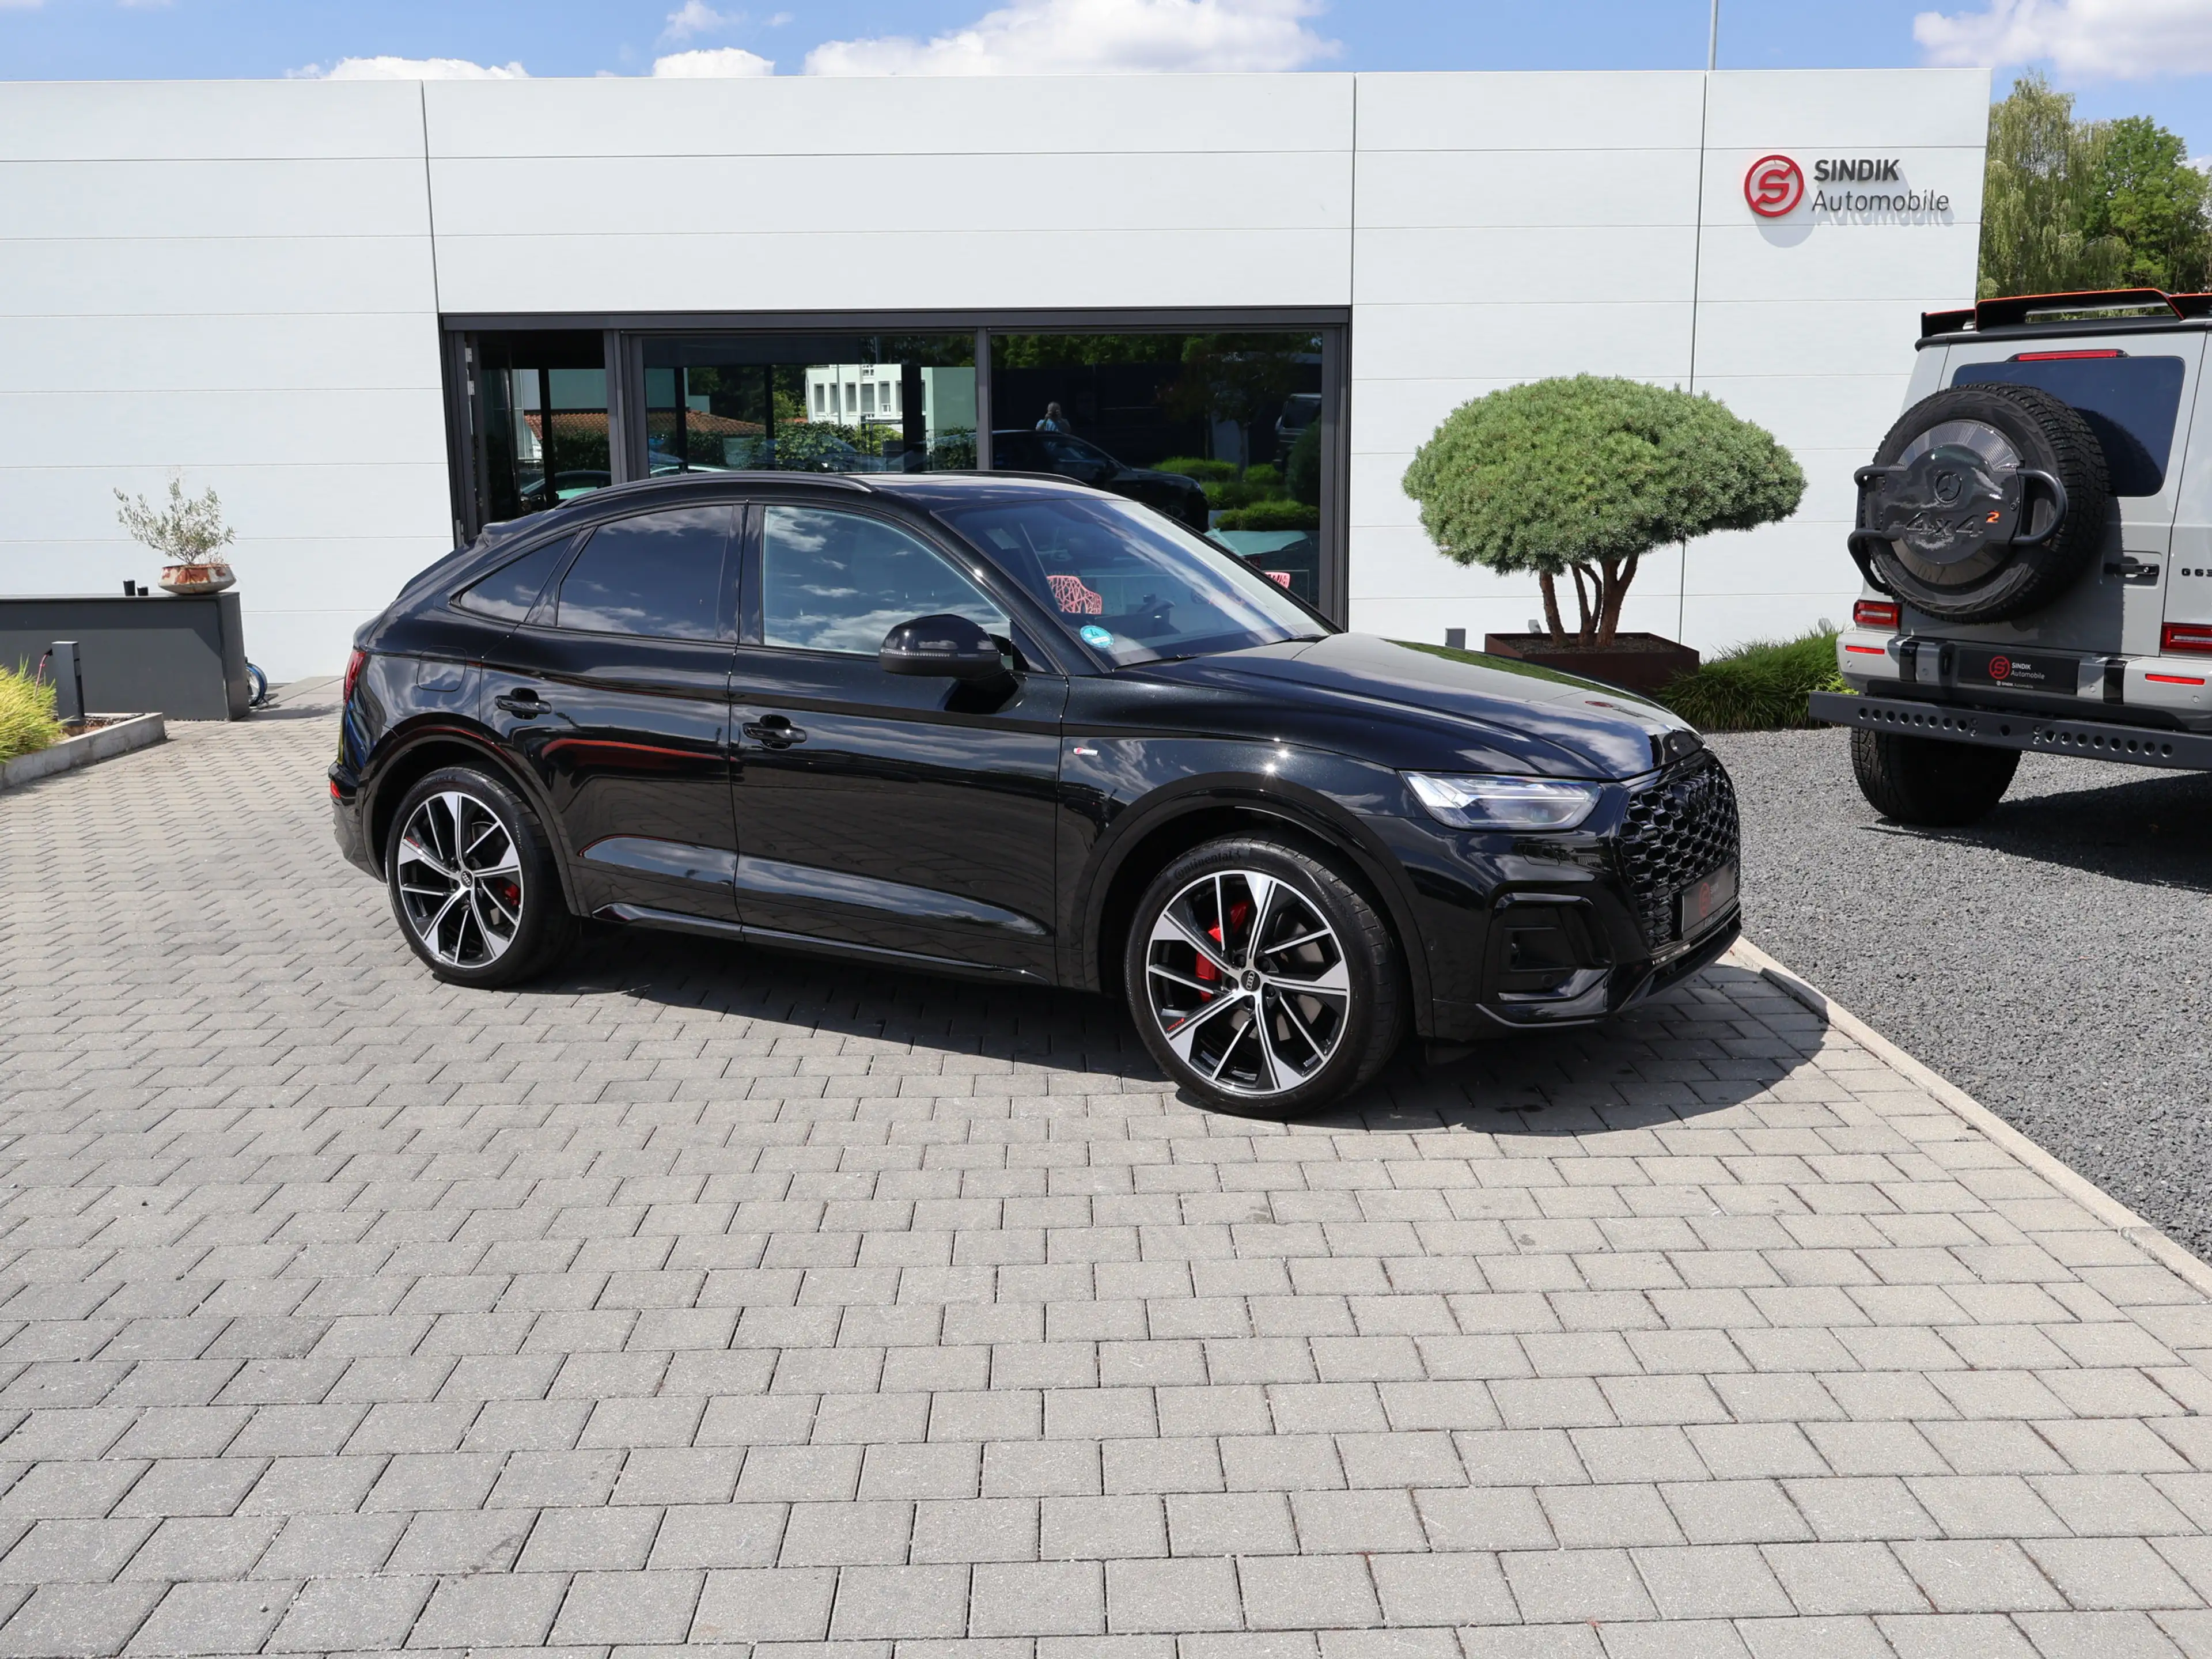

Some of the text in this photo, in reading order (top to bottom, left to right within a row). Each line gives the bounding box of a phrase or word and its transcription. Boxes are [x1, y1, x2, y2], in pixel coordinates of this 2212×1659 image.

[1814, 159, 1900, 182] SINDIK
[1812, 190, 1949, 212] Automobile
[2011, 662, 2032, 671] SINDIK
[2010, 670, 2046, 680] Automobile
